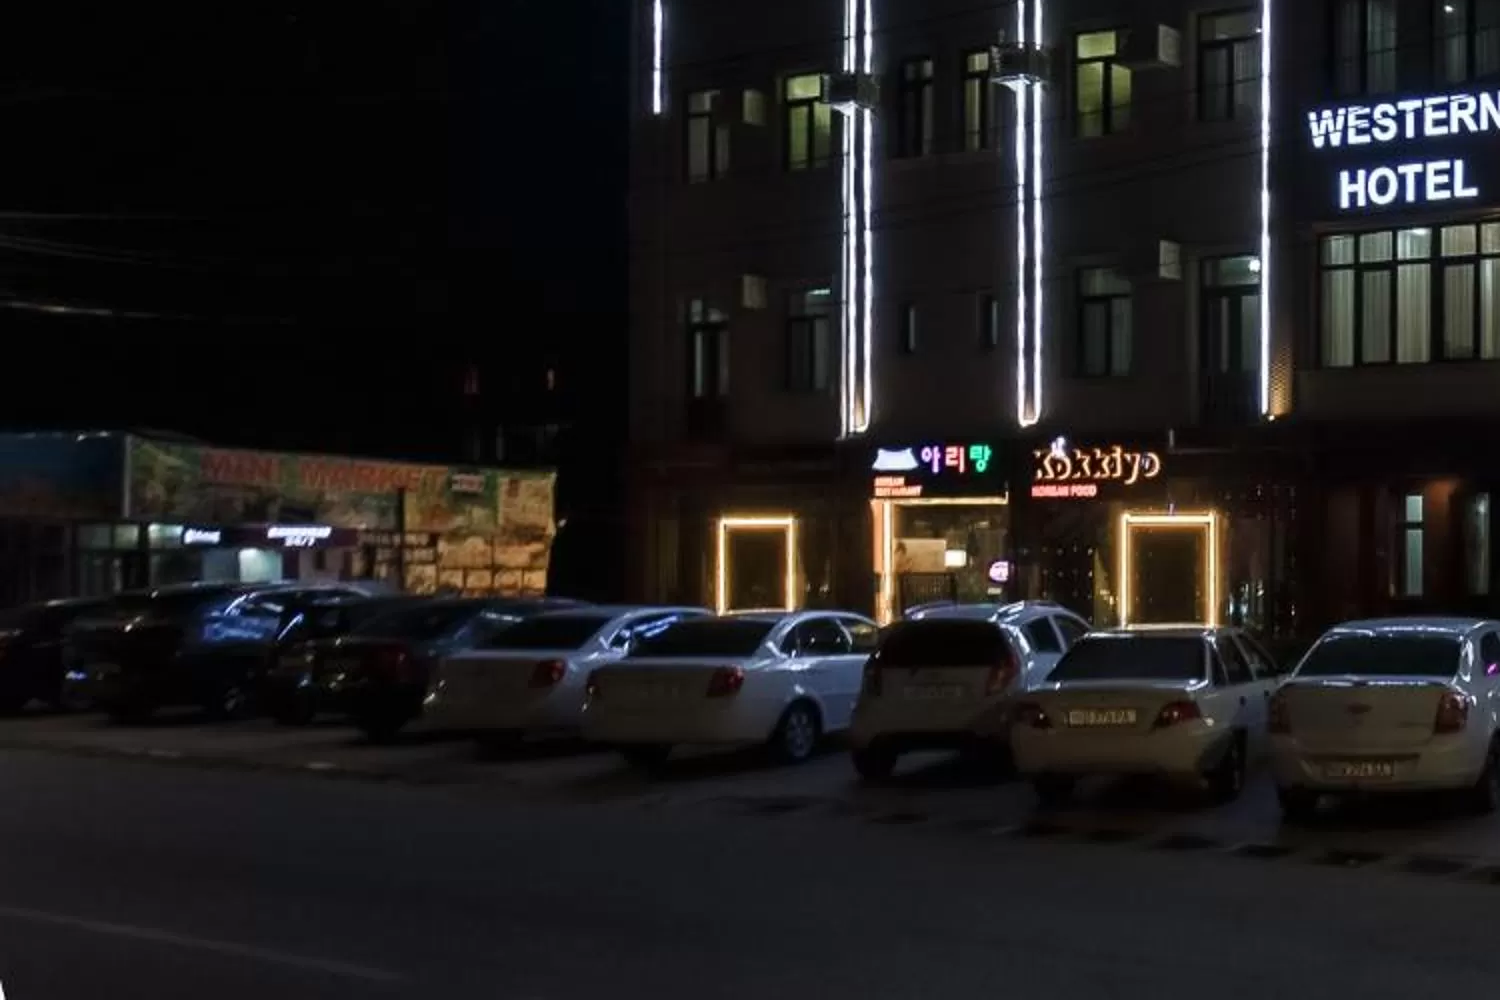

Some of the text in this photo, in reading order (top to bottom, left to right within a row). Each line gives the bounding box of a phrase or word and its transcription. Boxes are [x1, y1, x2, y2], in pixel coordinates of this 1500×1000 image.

[1339, 159, 1478, 209] HOTEL
[921, 445, 991, 474] 아리랑
[1071, 485, 1097, 497] FOOD
